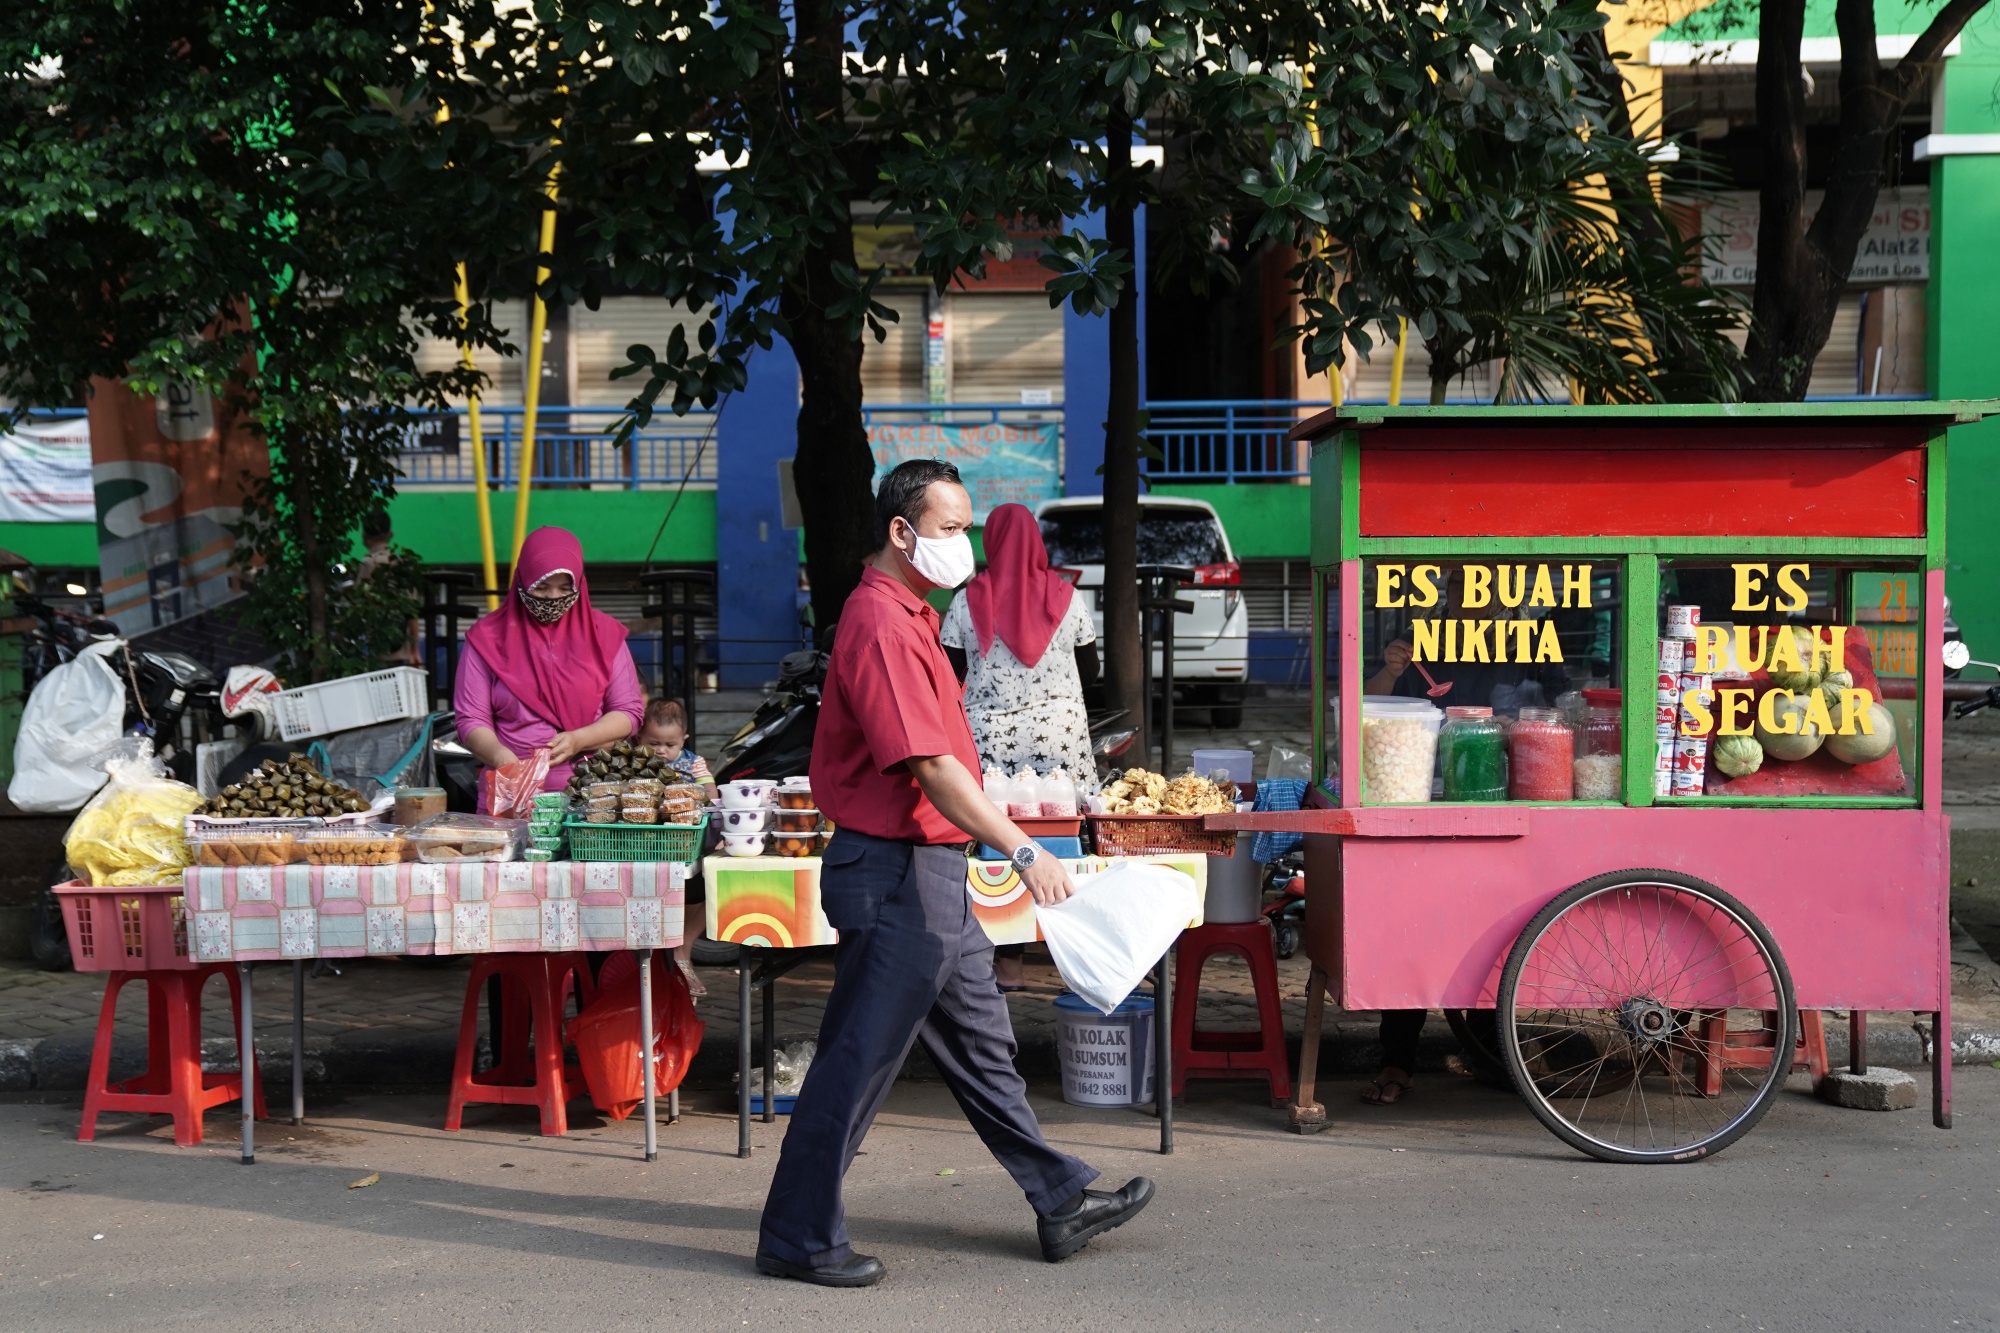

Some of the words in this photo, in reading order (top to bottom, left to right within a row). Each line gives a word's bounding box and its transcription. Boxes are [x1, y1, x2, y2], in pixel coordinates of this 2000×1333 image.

[866, 425, 947, 443] NGKEL
[959, 424, 1046, 444] MOBIL
[1375, 564, 1441, 608] ES
[1462, 564, 1593, 608] BUAH
[1732, 563, 1810, 612] ES
[1412, 620, 1564, 663] NIKITA
[1693, 625, 1848, 675] BUAH
[1681, 688, 1875, 737] SEGAR
[1079, 1028, 1126, 1046] KOLAK
[1075, 1049, 1127, 1067] SUMSUM
[1078, 1082, 1099, 1096] 1642
[1102, 1083, 1127, 1096] 8881
[1079, 1070, 1115, 1080] PESANAN
